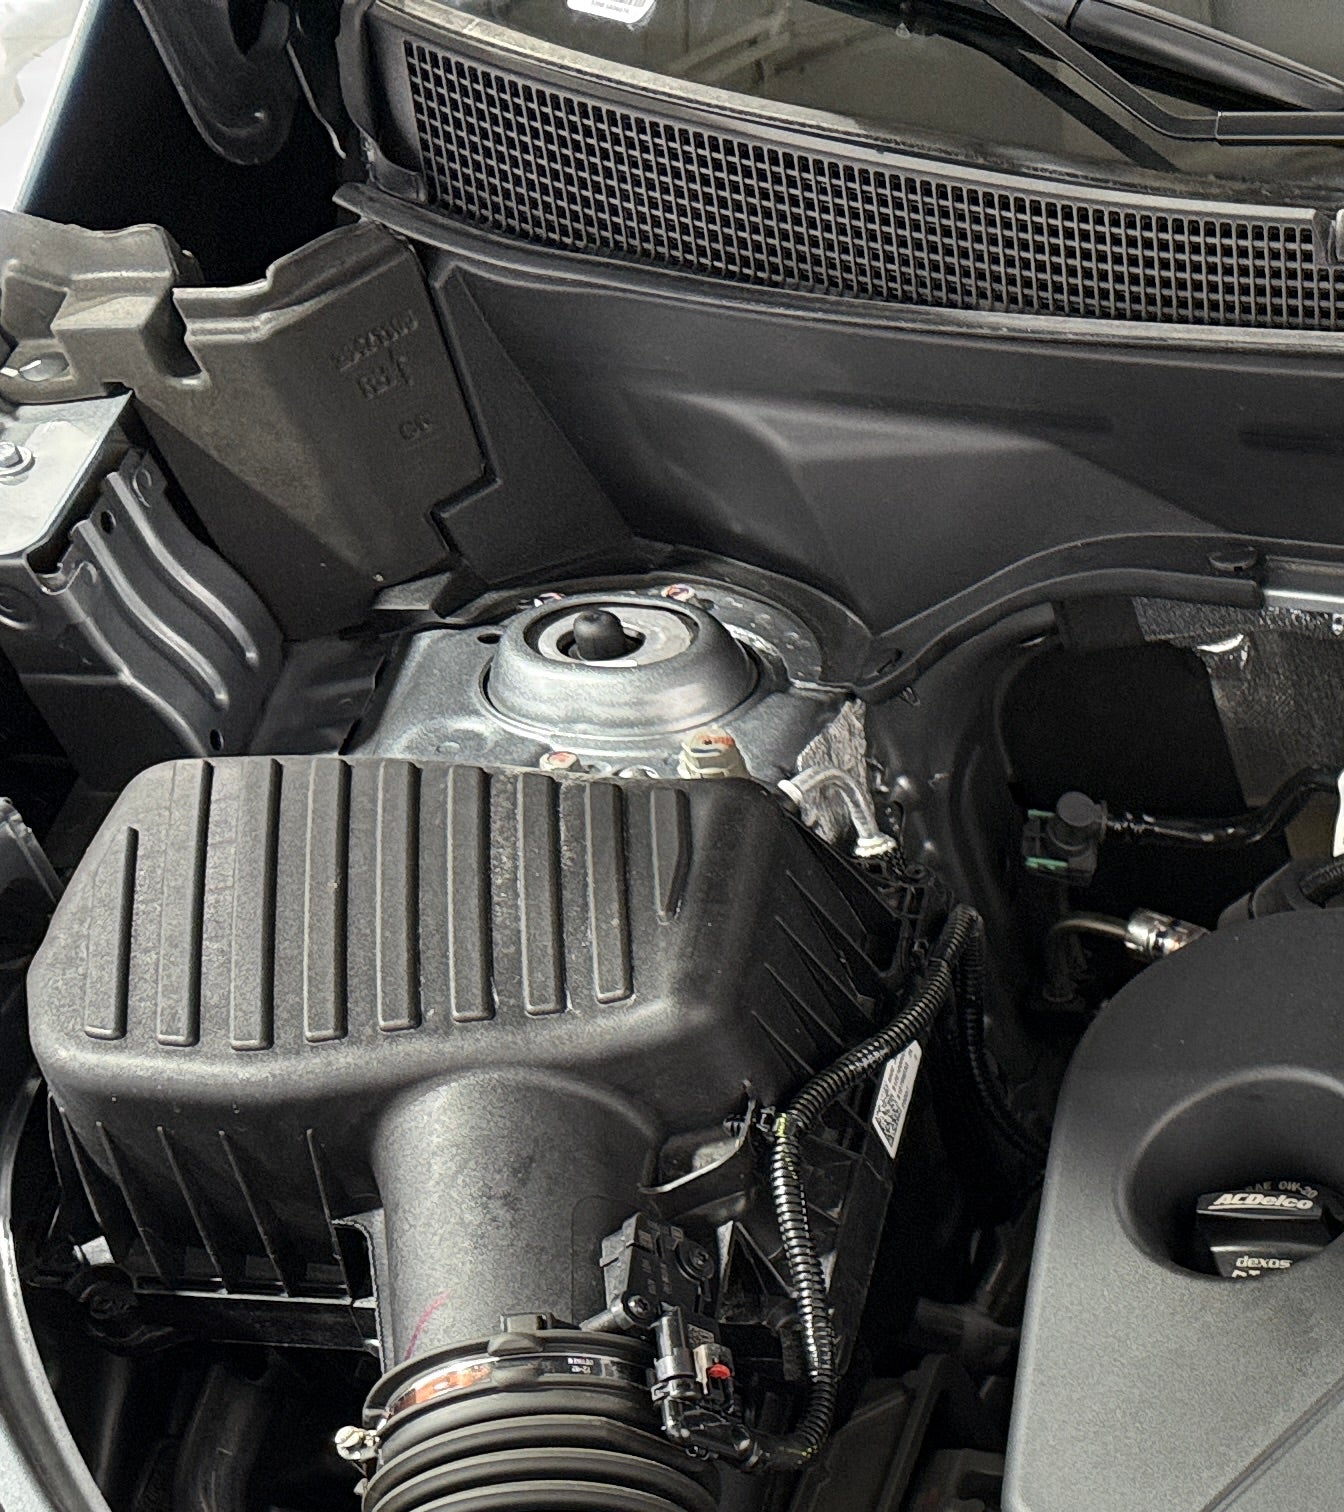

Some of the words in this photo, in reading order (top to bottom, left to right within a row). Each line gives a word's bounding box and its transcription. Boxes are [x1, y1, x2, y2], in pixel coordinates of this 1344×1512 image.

[1279, 1181, 1318, 1199] 0W-20
[1213, 1193, 1314, 1210] ACDelco
[1236, 1256, 1293, 1269] dexos
